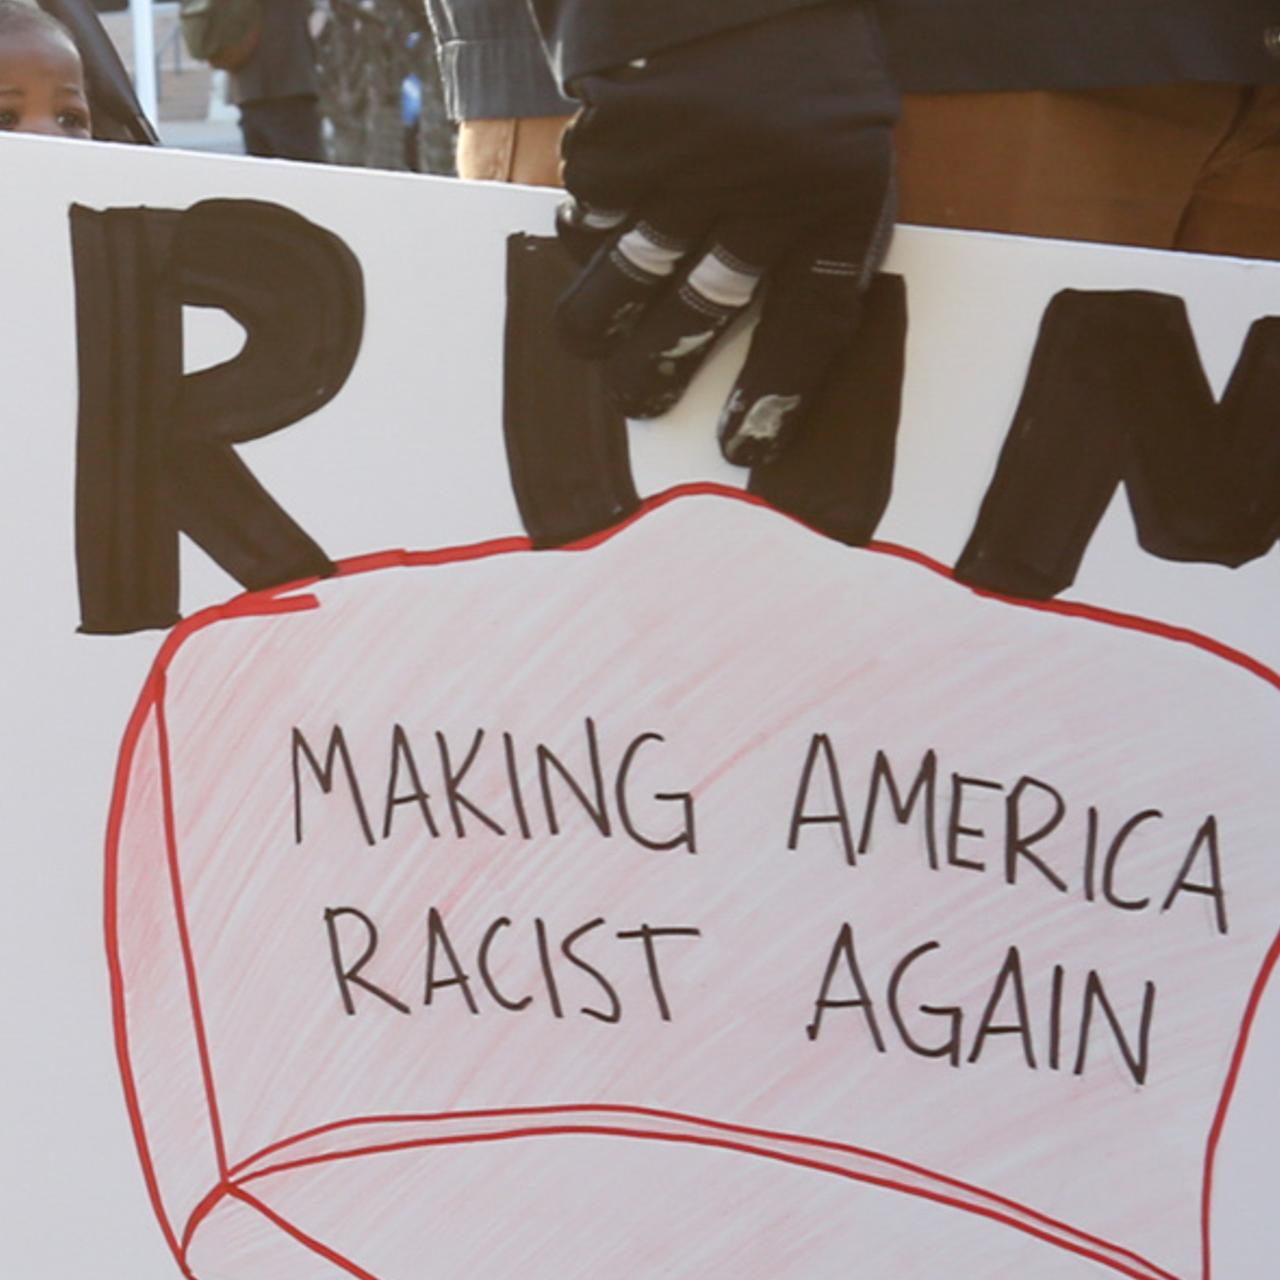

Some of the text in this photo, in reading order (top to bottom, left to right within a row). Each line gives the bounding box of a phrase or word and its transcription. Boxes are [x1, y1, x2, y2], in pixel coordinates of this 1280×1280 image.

[291, 718, 1230, 936] MAKING AMERICA
[321, 904, 1159, 1086] RACIST AGAIN
